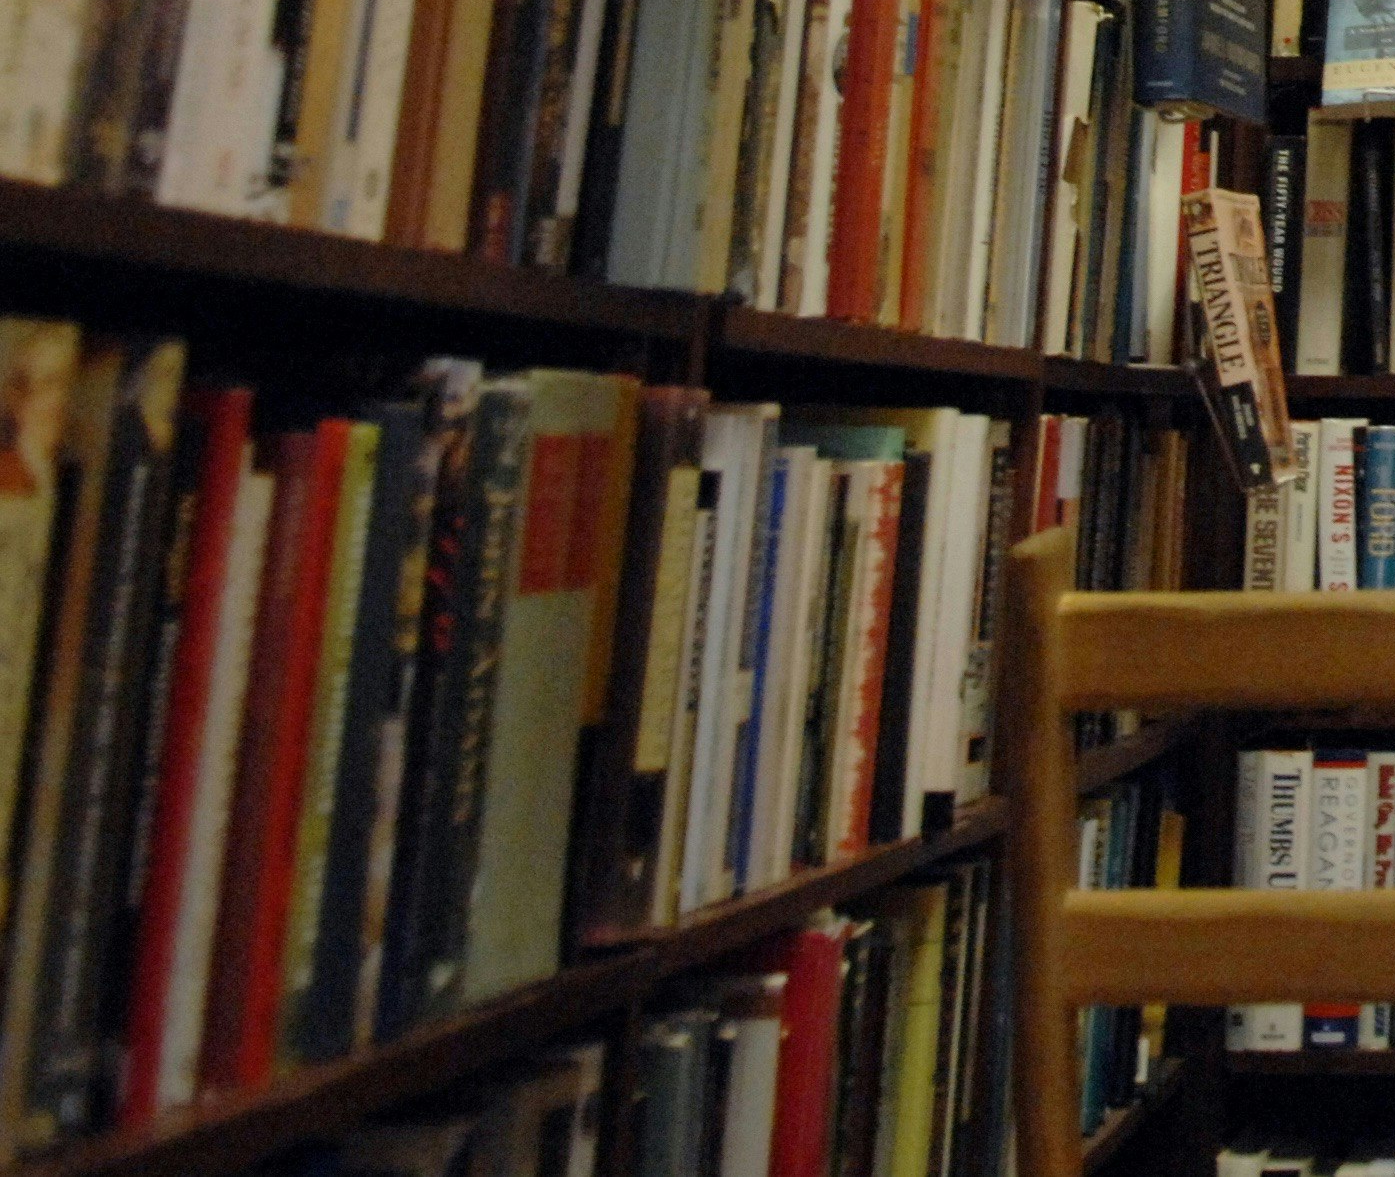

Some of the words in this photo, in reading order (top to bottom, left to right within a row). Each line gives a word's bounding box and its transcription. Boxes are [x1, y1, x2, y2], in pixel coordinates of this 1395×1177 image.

[1278, 150, 1290, 171] THE
[1274, 177, 1288, 244] FIFTY-YEAR
[1272, 248, 1285, 293] WOUND
[1191, 240, 1246, 375] TRIANGLE
[1331, 464, 1355, 544] NIXON'S
[1269, 768, 1303, 867] THUMBS
